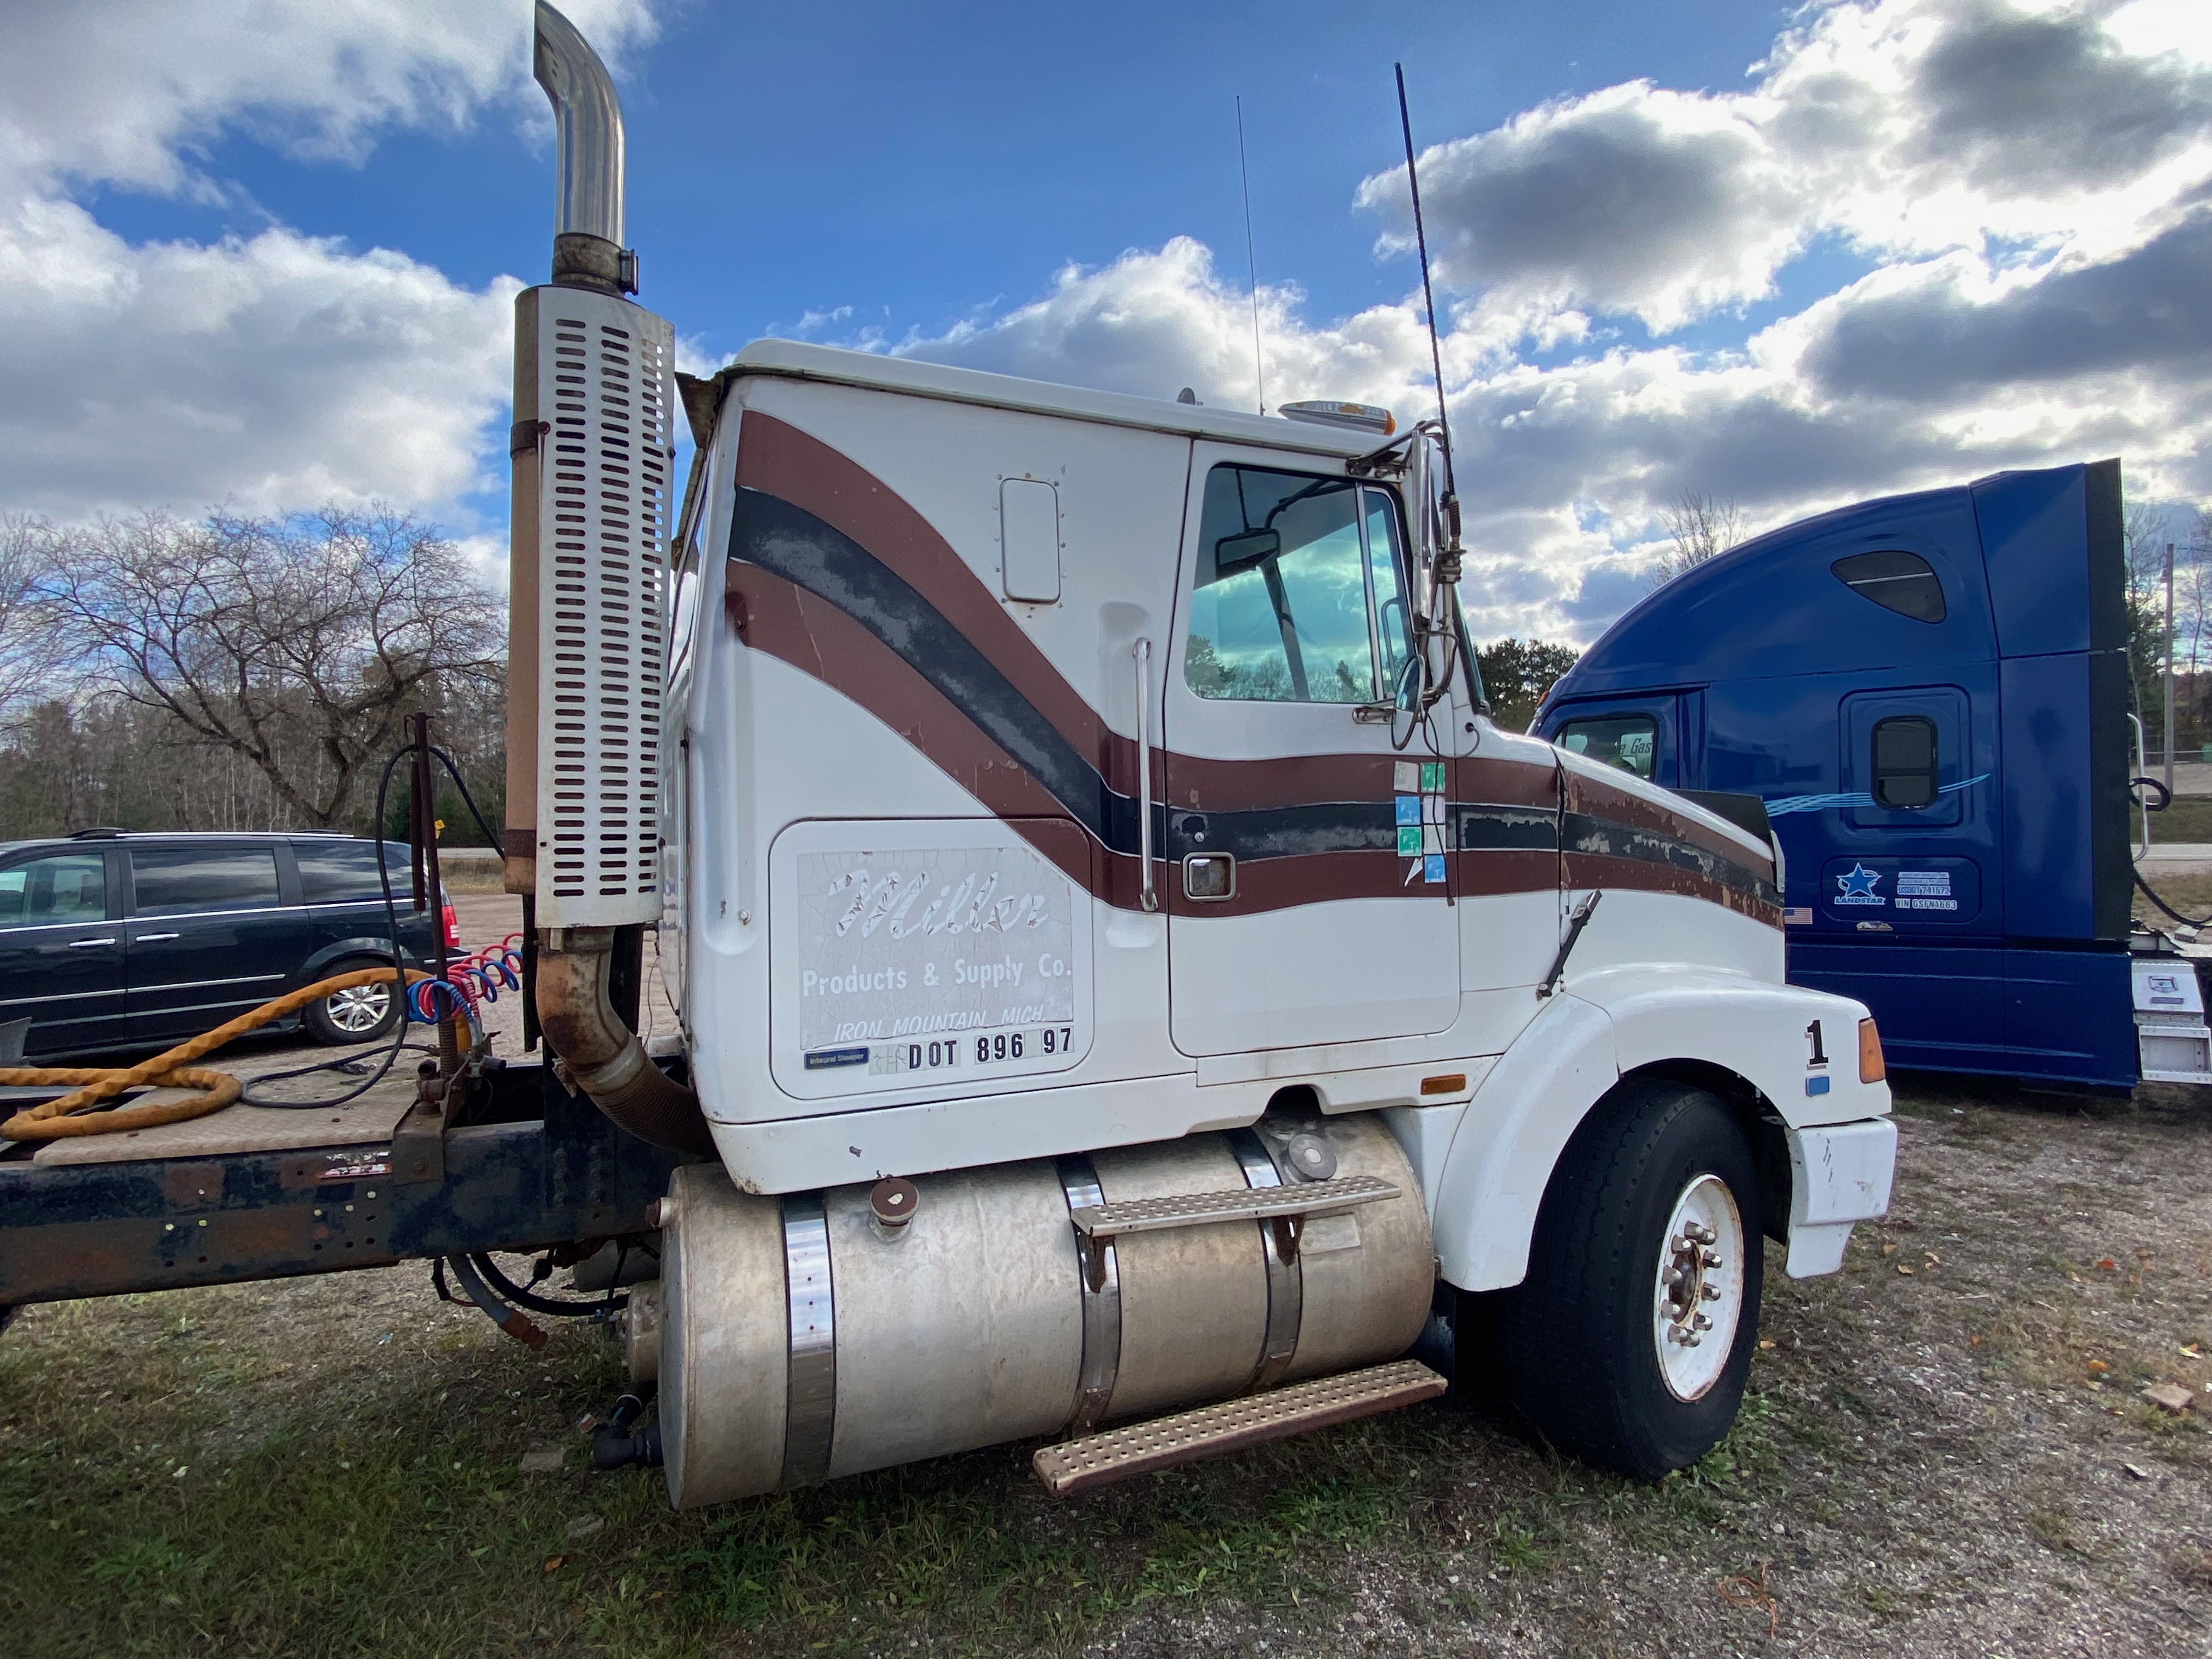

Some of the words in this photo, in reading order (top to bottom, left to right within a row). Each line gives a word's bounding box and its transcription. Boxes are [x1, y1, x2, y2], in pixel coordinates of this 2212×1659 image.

[1630, 738, 1652, 753] Gas
[828, 868, 1048, 939] Miller
[803, 964, 907, 996] Products
[923, 963, 939, 986] &
[955, 954, 1024, 989] Supply
[1039, 953, 1072, 978] Co.
[834, 1019, 882, 1042] IRON
[909, 1040, 957, 1070] DOT
[977, 1033, 1023, 1062] 896
[1043, 1027, 1071, 1054] 97
[1805, 1019, 1829, 1067] 1
